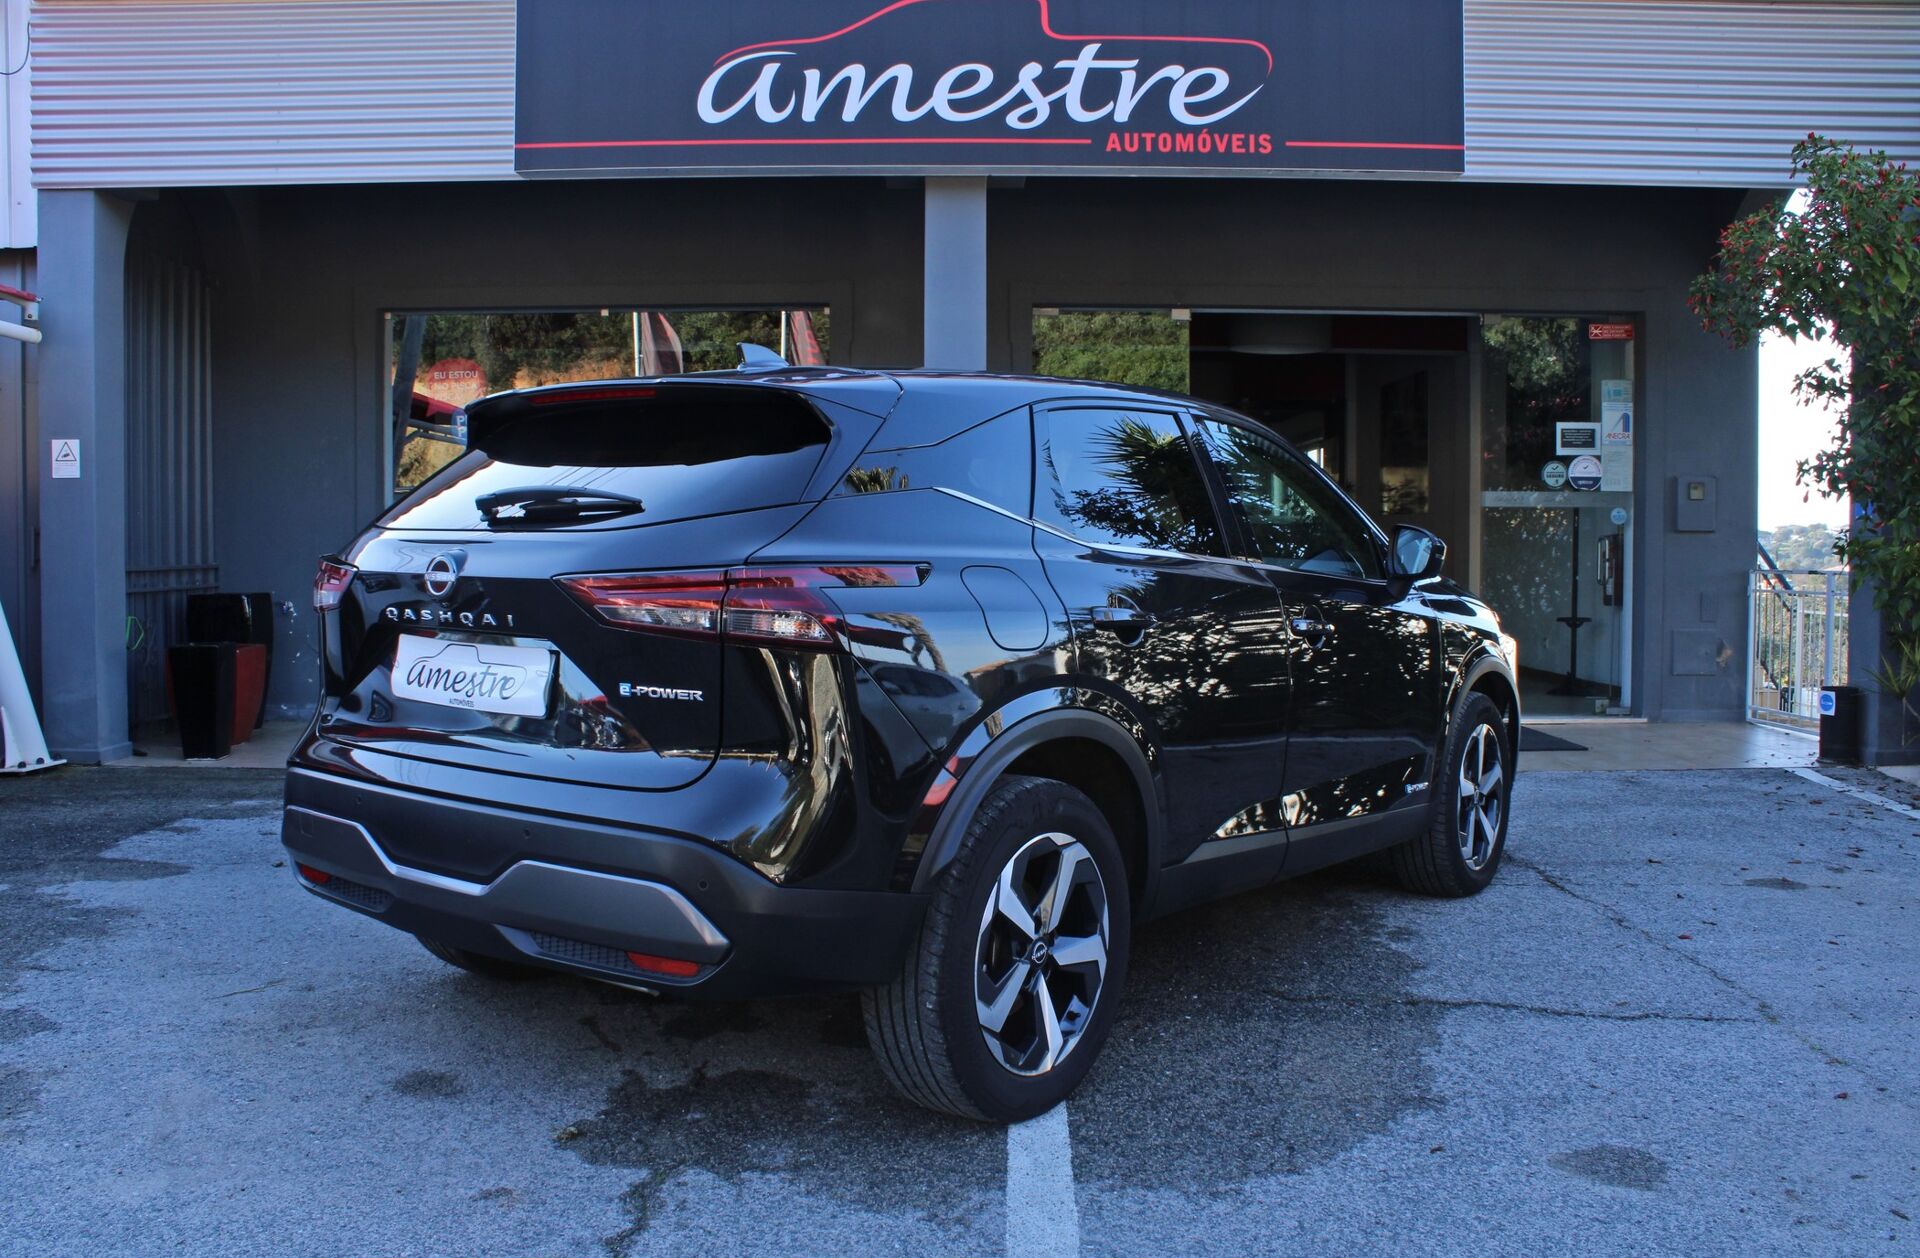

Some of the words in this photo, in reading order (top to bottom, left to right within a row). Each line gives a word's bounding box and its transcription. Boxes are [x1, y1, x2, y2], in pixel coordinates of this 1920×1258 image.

[696, 43, 1264, 129] amestre
[1105, 129, 1273, 154] AUTOMÓVEIS
[434, 371, 446, 380] EU
[448, 370, 478, 379] ESTOU
[385, 607, 514, 627] QASHQAI
[406, 659, 522, 700] amestre
